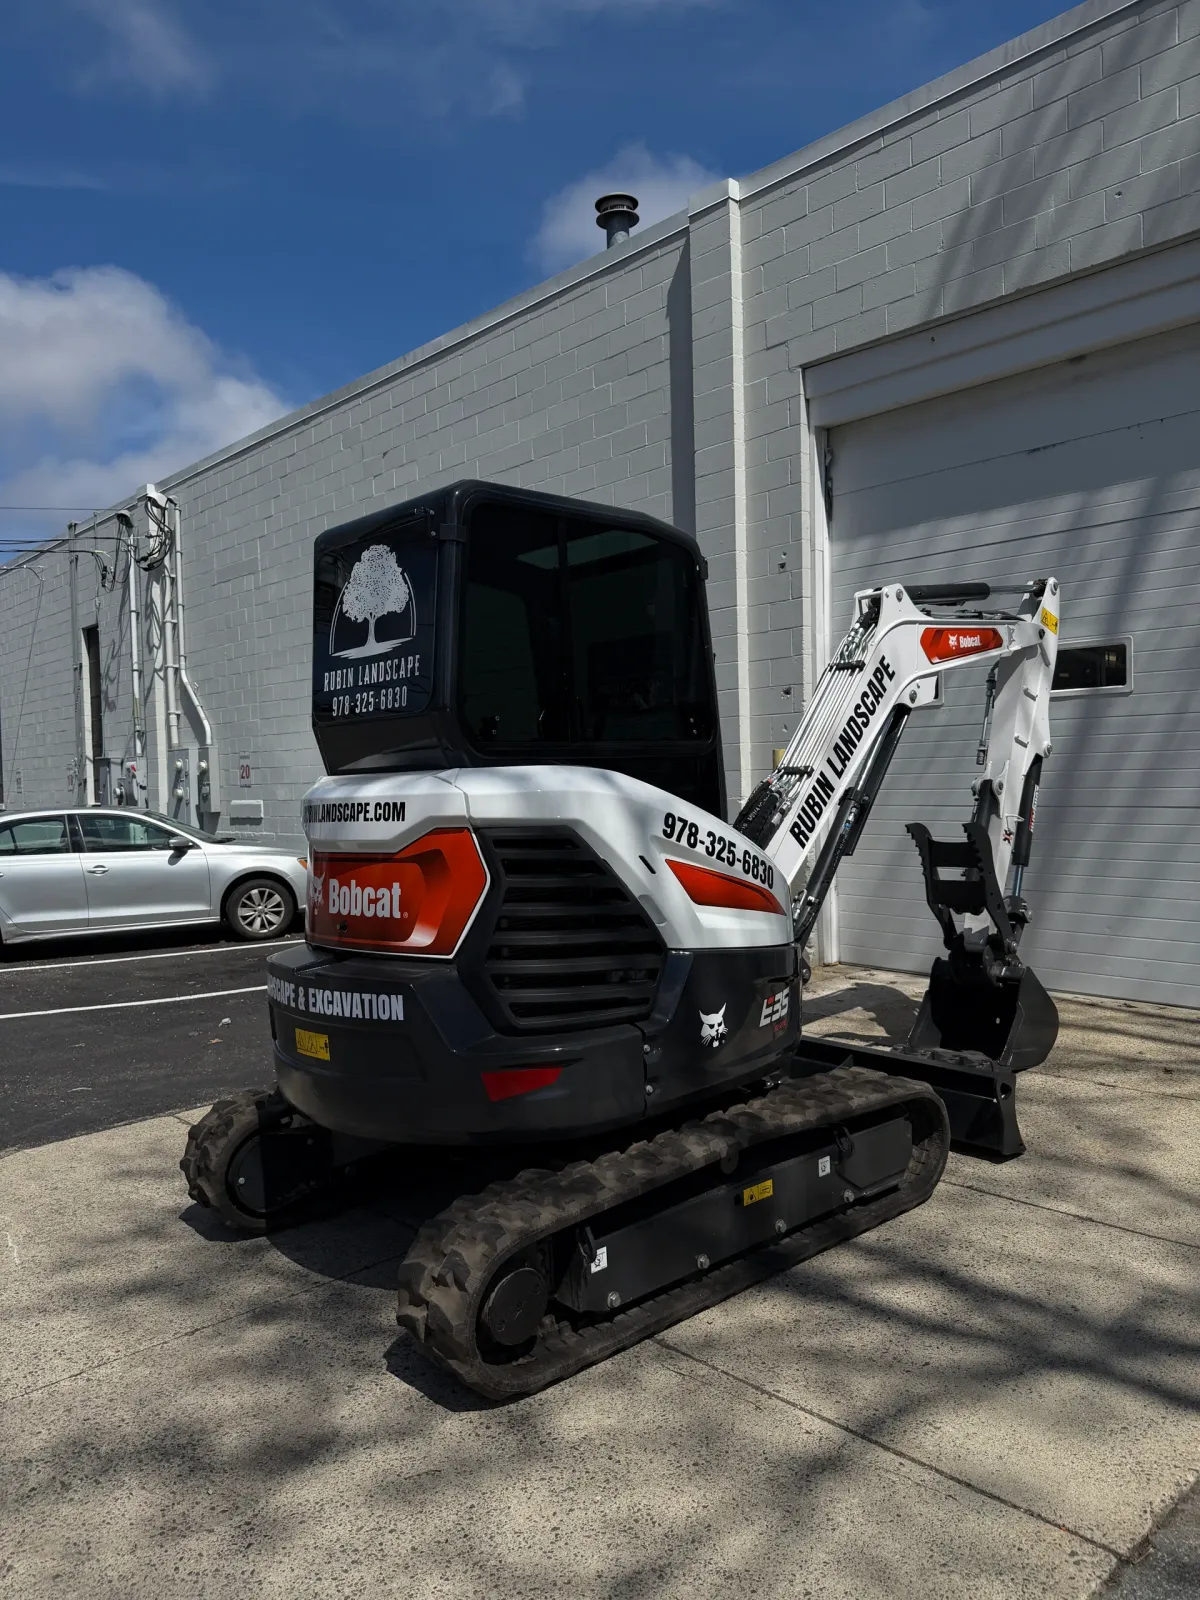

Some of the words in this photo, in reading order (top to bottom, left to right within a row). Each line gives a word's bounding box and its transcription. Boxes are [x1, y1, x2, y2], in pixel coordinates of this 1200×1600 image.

[959, 634, 980, 648] Bobcat
[323, 667, 354, 692] RUBIN
[358, 654, 421, 686] LANDSCAPE
[332, 685, 408, 717] 978-325-6830
[788, 770, 836, 850] RUBIN
[826, 655, 896, 781] LANDSCAPE
[240, 764, 251, 780] 20
[662, 812, 774, 890] 978-325-6830
[328, 878, 402, 919] Bobcat
[298, 986, 306, 1011] &
[308, 987, 405, 1021] EXCAVATION
